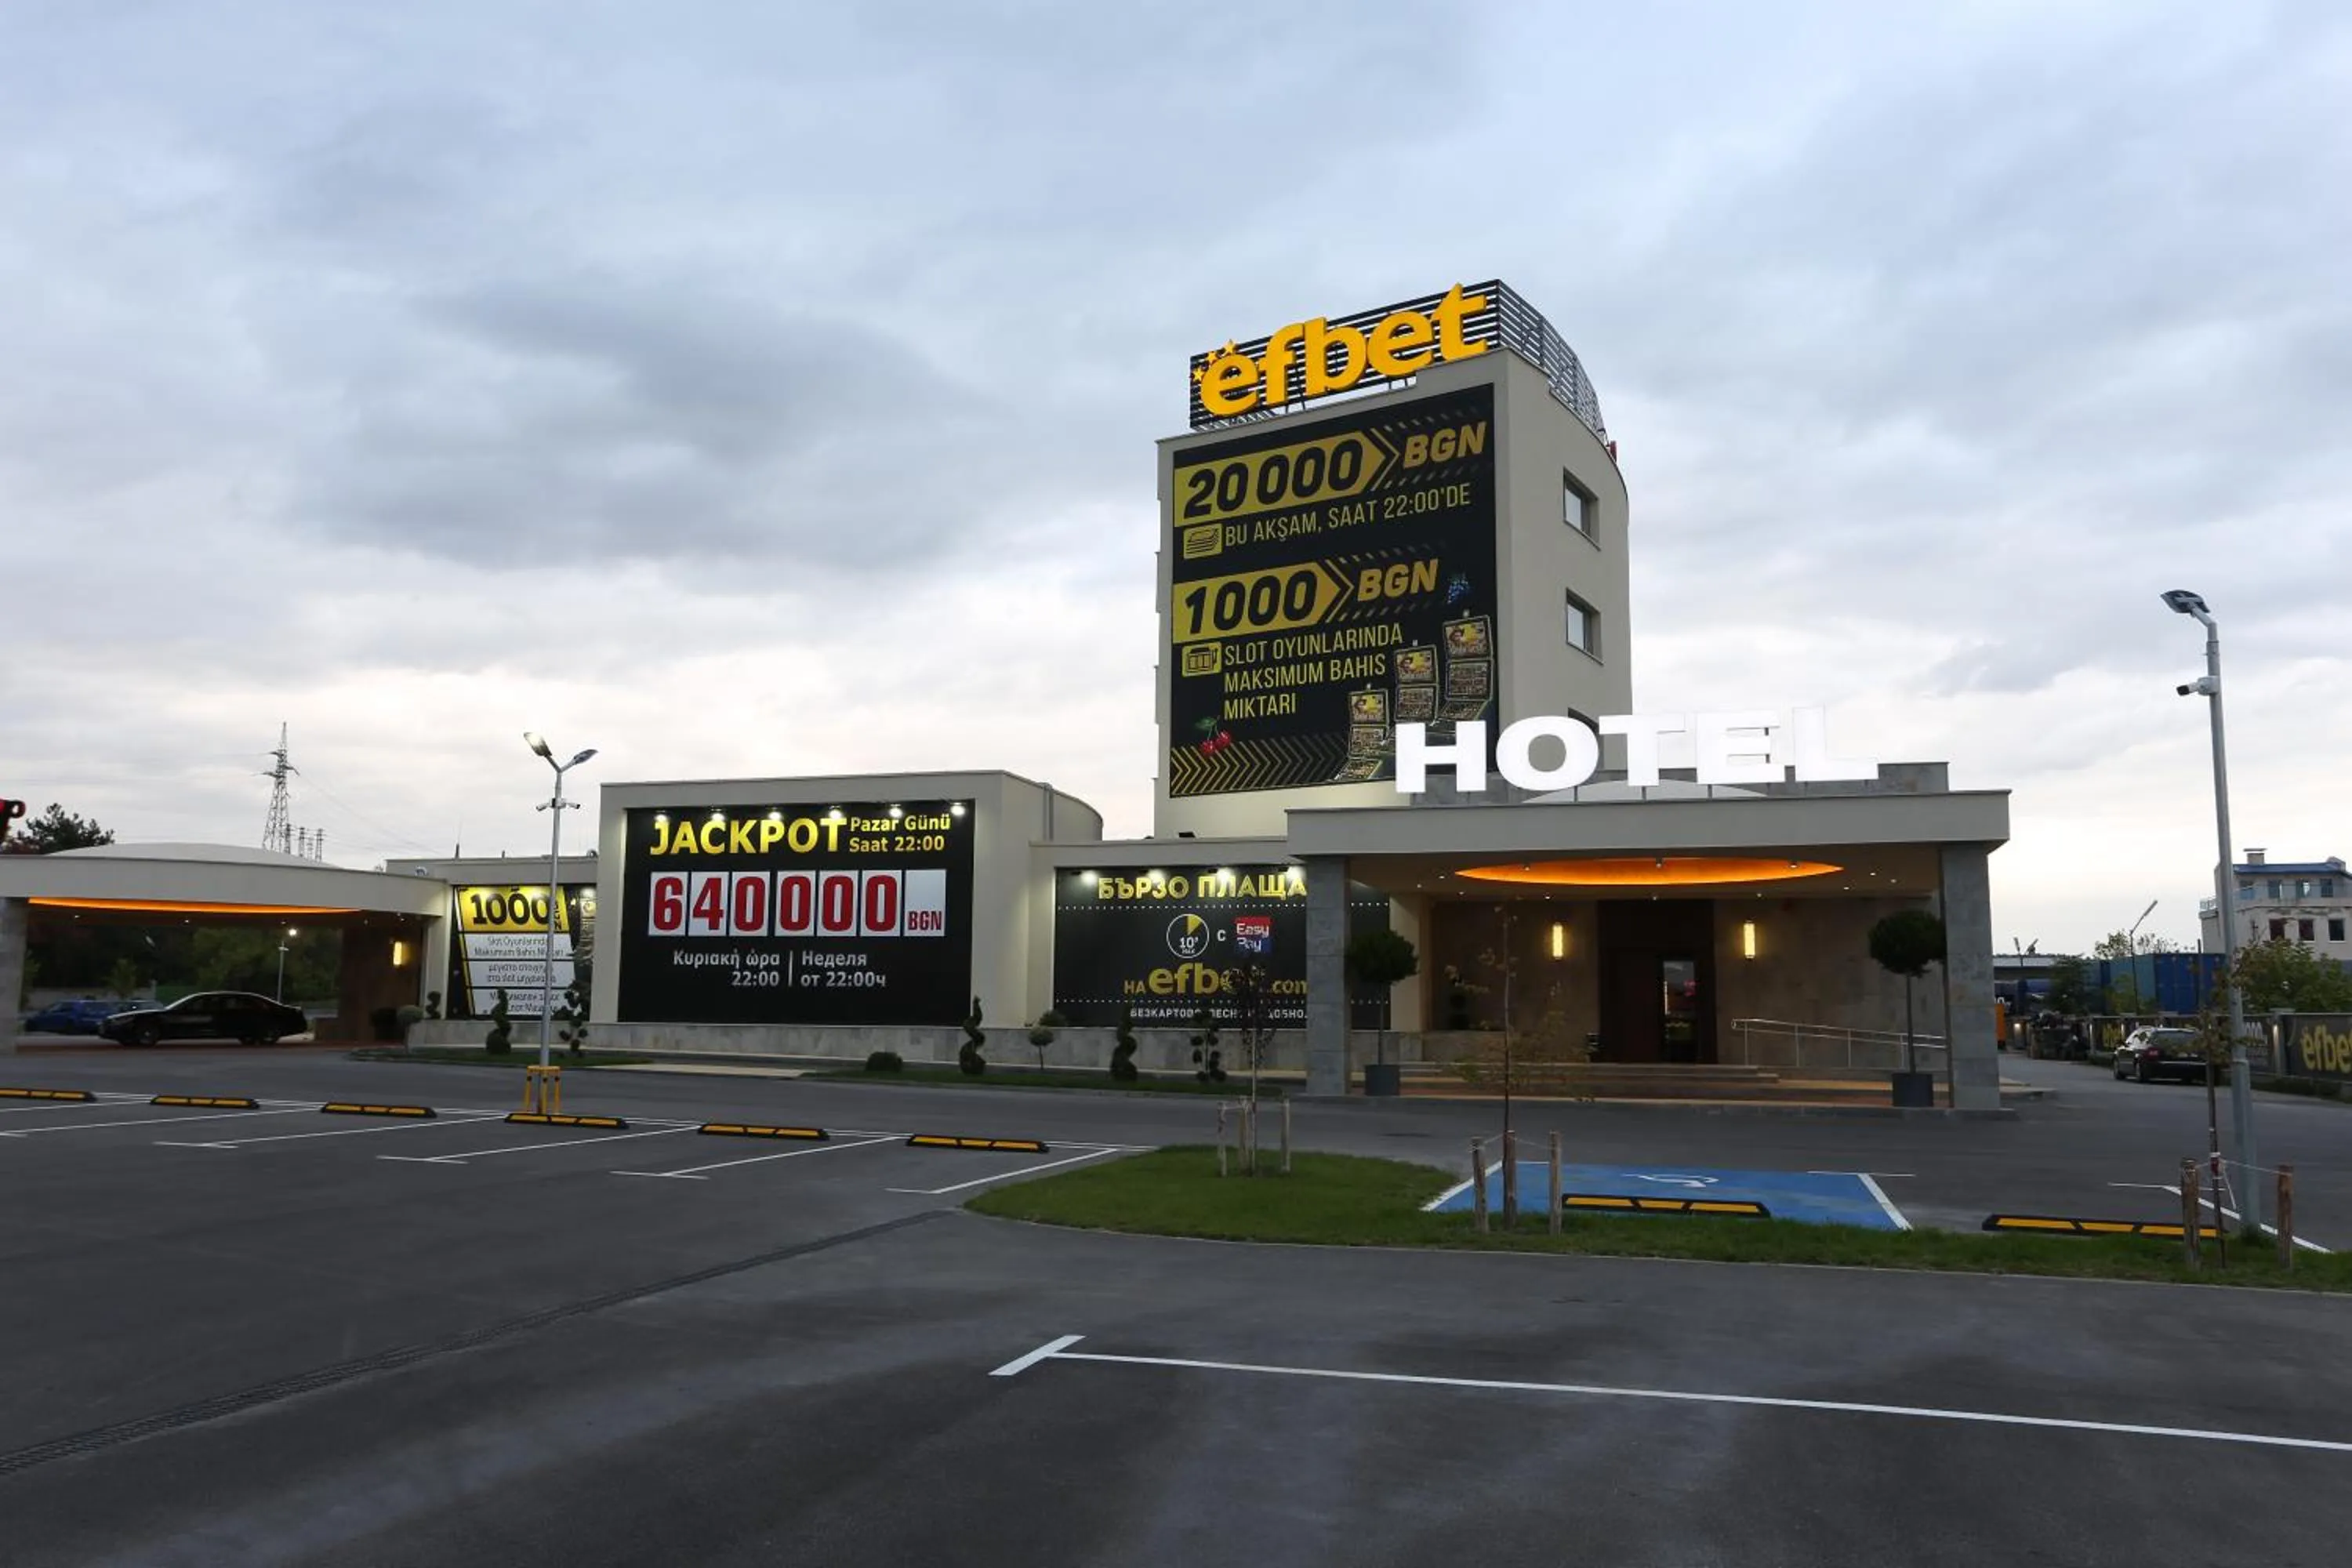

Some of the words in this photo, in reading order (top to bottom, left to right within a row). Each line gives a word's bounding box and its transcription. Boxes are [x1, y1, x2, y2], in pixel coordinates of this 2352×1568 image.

[1200, 283, 1487, 416] efbet
[1403, 422, 1486, 469] BGN
[1225, 524, 1247, 547] BU
[1254, 513, 1322, 541] AKŞAM,
[1329, 501, 1377, 528] SAAT
[1384, 483, 1471, 519] 22:00'DE
[1185, 571, 1317, 633] 1000
[1358, 559, 1439, 602] BGN
[1225, 641, 1268, 666] SLOT
[1273, 622, 1403, 659] OYUNLARINDA
[1225, 662, 1323, 693] MAKSIMUM
[1330, 653, 1386, 681] BAHIS
[1225, 692, 1297, 720] MIKTARI
[1396, 707, 1879, 793] HOTEL
[851, 817, 899, 831] Pazar
[905, 813, 951, 830] Günü
[650, 818, 847, 855] JACKPOT
[849, 837, 888, 852] Saat
[895, 835, 945, 851] 22:00
[1098, 876, 1189, 899] БЪРЗО
[908, 911, 942, 931] BGN
[1236, 923, 1269, 938] Easy
[674, 948, 739, 969] Κυριακή
[802, 950, 866, 968] Неделя
[731, 971, 779, 986] 22:00
[800, 975, 820, 986] от
[826, 971, 886, 986] 22:00ч
